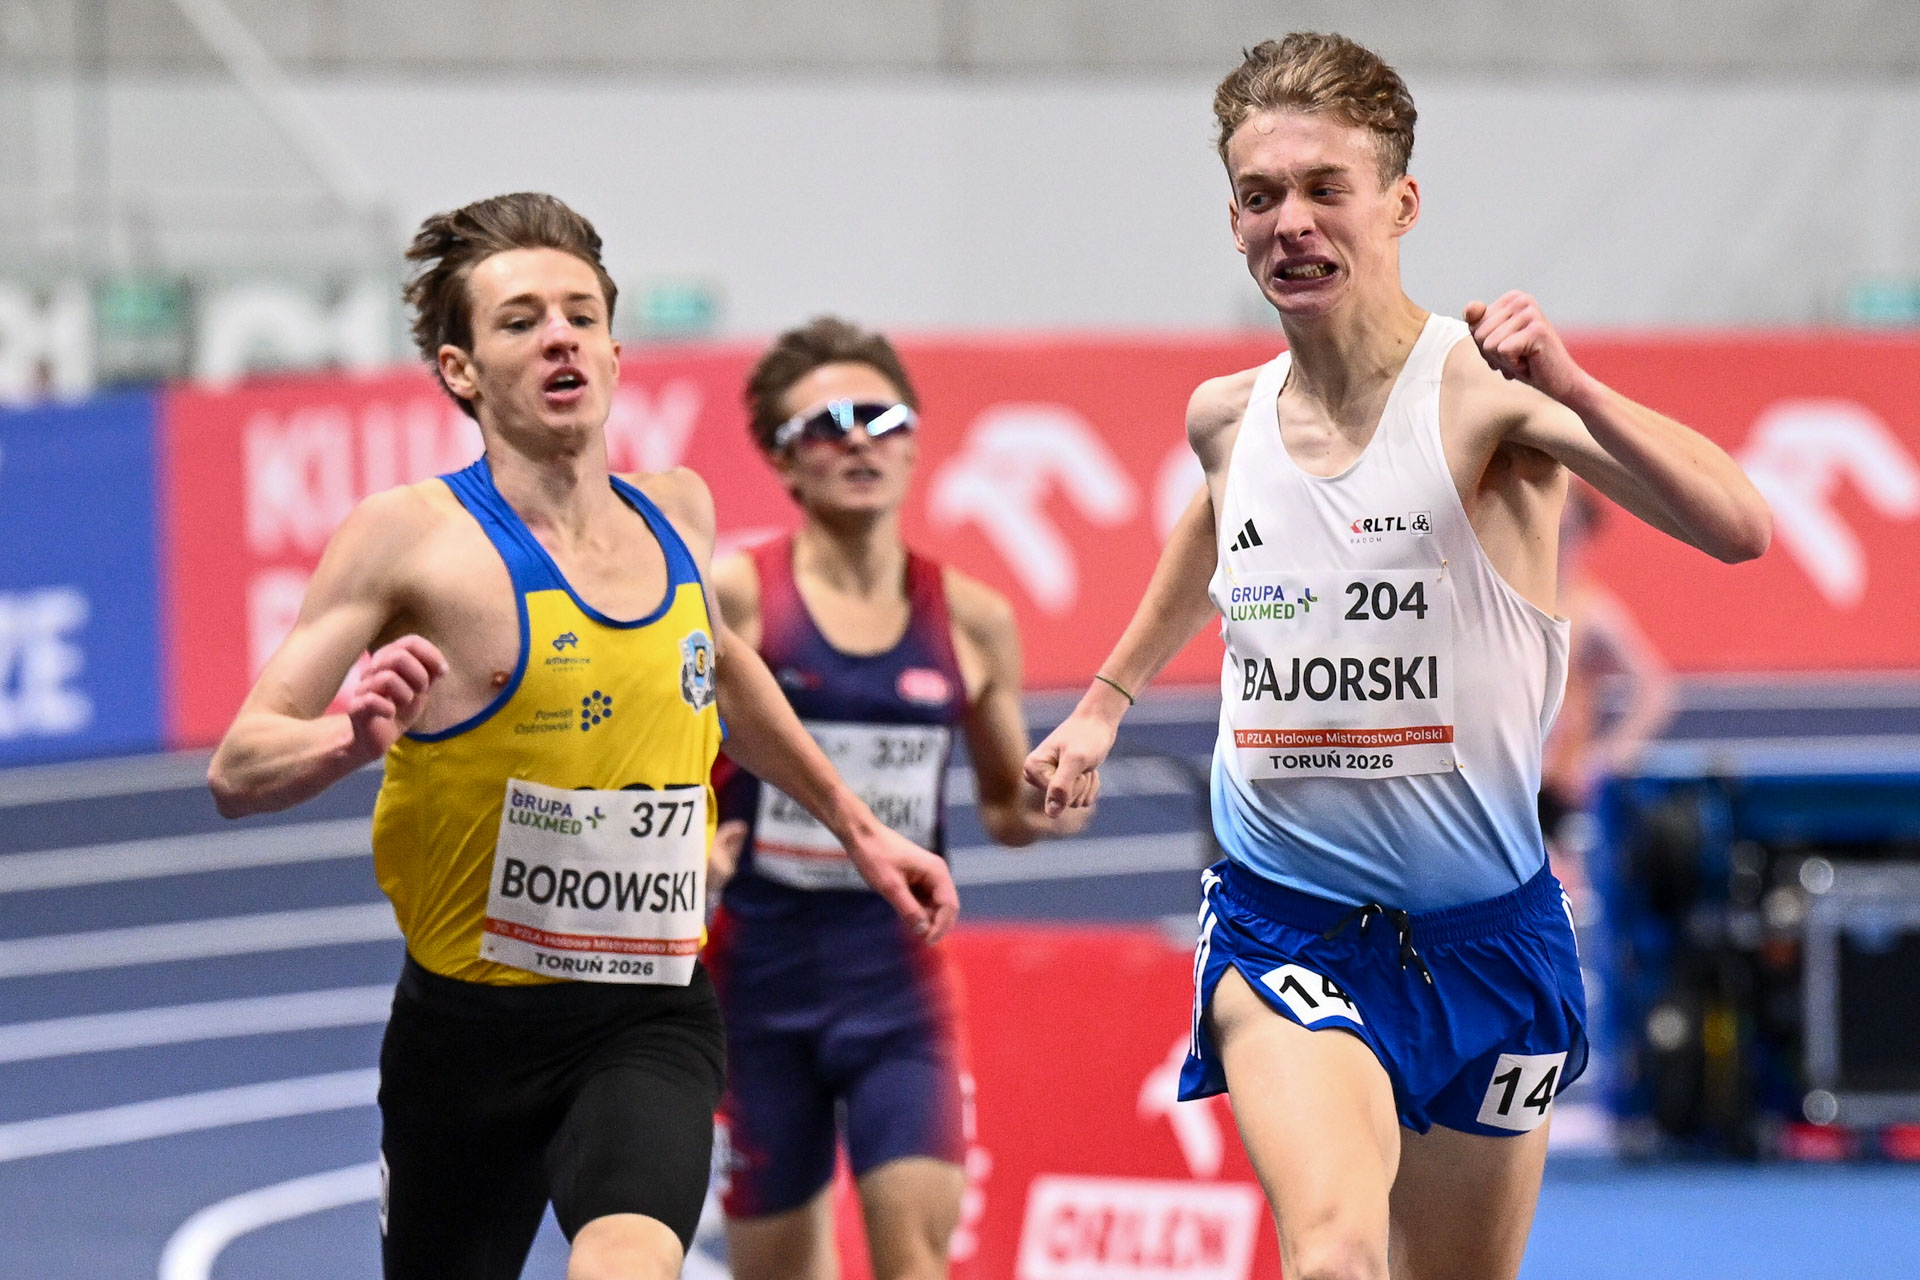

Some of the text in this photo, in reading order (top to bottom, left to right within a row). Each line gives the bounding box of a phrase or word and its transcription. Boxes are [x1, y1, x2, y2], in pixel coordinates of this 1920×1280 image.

[1362, 516, 1407, 533] RLTL
[1231, 585, 1285, 602] GRUPA
[1344, 581, 1428, 620] 204
[1230, 603, 1295, 621] LUXMED
[1242, 656, 1438, 701] BAJORSKI
[1236, 728, 1443, 745] 70. PZLA Halowe Mistrzostwa Polski
[1269, 750, 1394, 769] TORUŃ 2026
[512, 793, 573, 817] GRUPA
[508, 808, 583, 835] LUXMED
[630, 800, 695, 837] 377
[501, 857, 697, 913] BOROWSKI
[535, 952, 655, 976] TORUŃ 2026
[1279, 975, 1352, 1009] 14
[1493, 1065, 1558, 1116] 14
